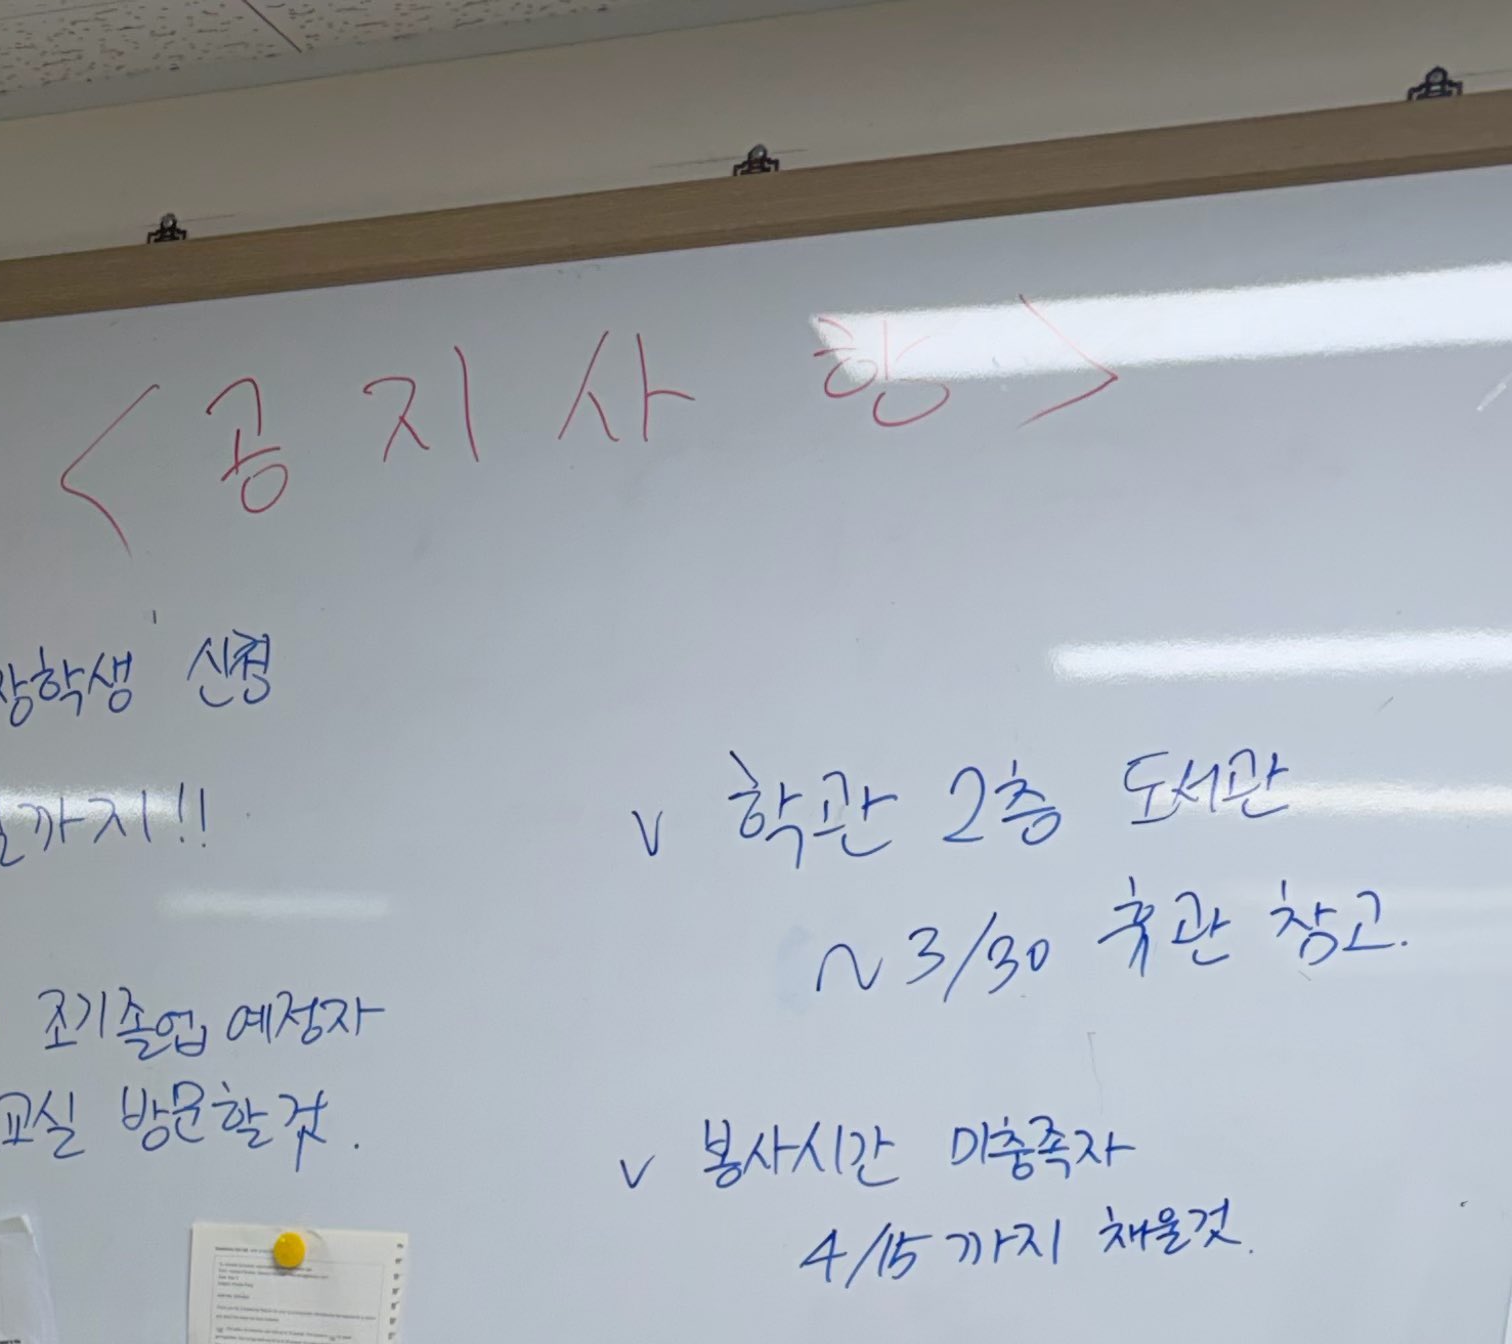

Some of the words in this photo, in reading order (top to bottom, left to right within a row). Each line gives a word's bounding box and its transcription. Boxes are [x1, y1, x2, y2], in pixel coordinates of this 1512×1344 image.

[729, 750, 898, 869] 학관
[943, 759, 1062, 844] 2층
[1125, 747, 1290, 826] 도서관
[227, 991, 385, 1050] 예정자
[702, 1118, 900, 1188] 봉사시간
[952, 1114, 1138, 1180] 미충족자
